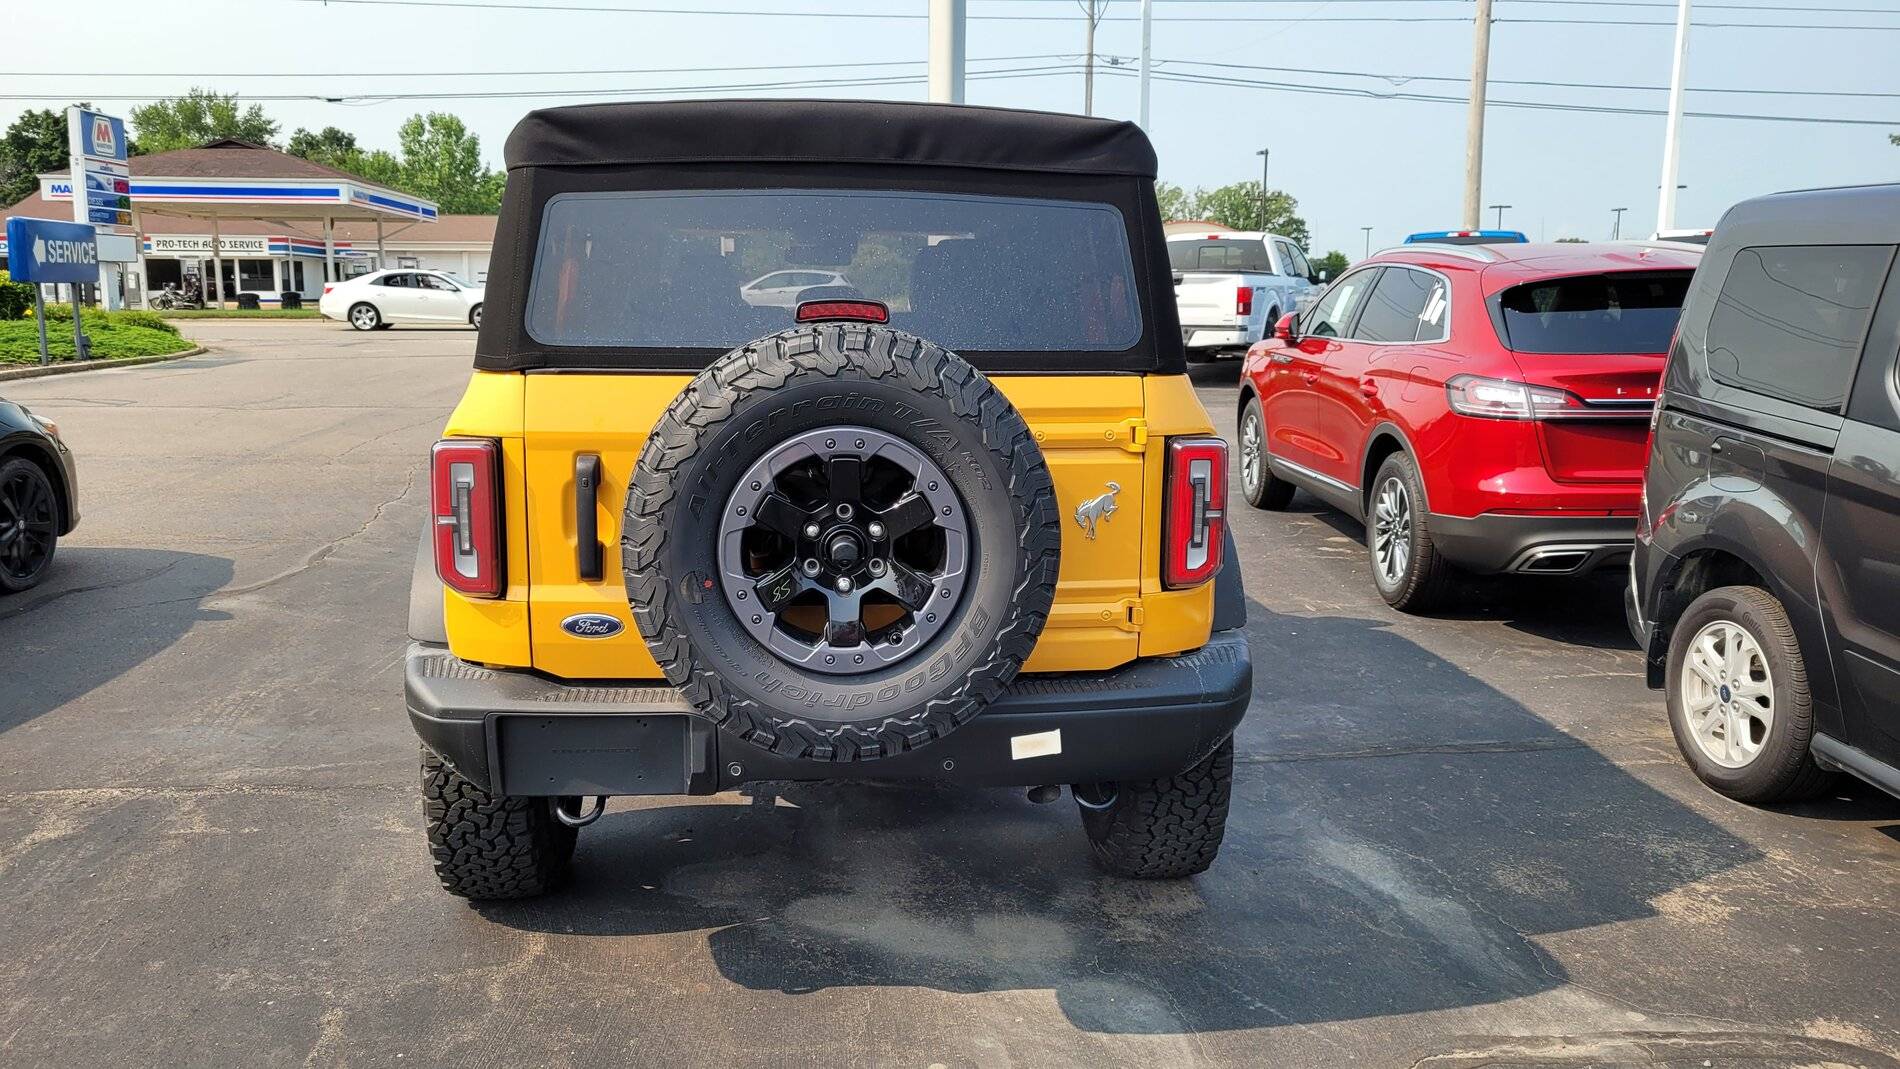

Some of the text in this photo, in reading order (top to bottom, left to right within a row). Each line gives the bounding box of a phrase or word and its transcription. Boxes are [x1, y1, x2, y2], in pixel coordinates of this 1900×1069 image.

[97, 123, 111, 143] M
[48, 240, 96, 265] SERVICE
[156, 239, 263, 249] PRO-TECH AUO SERVICE
[575, 619, 609, 633] Ford
[753, 604, 991, 710] BFGoodrich
